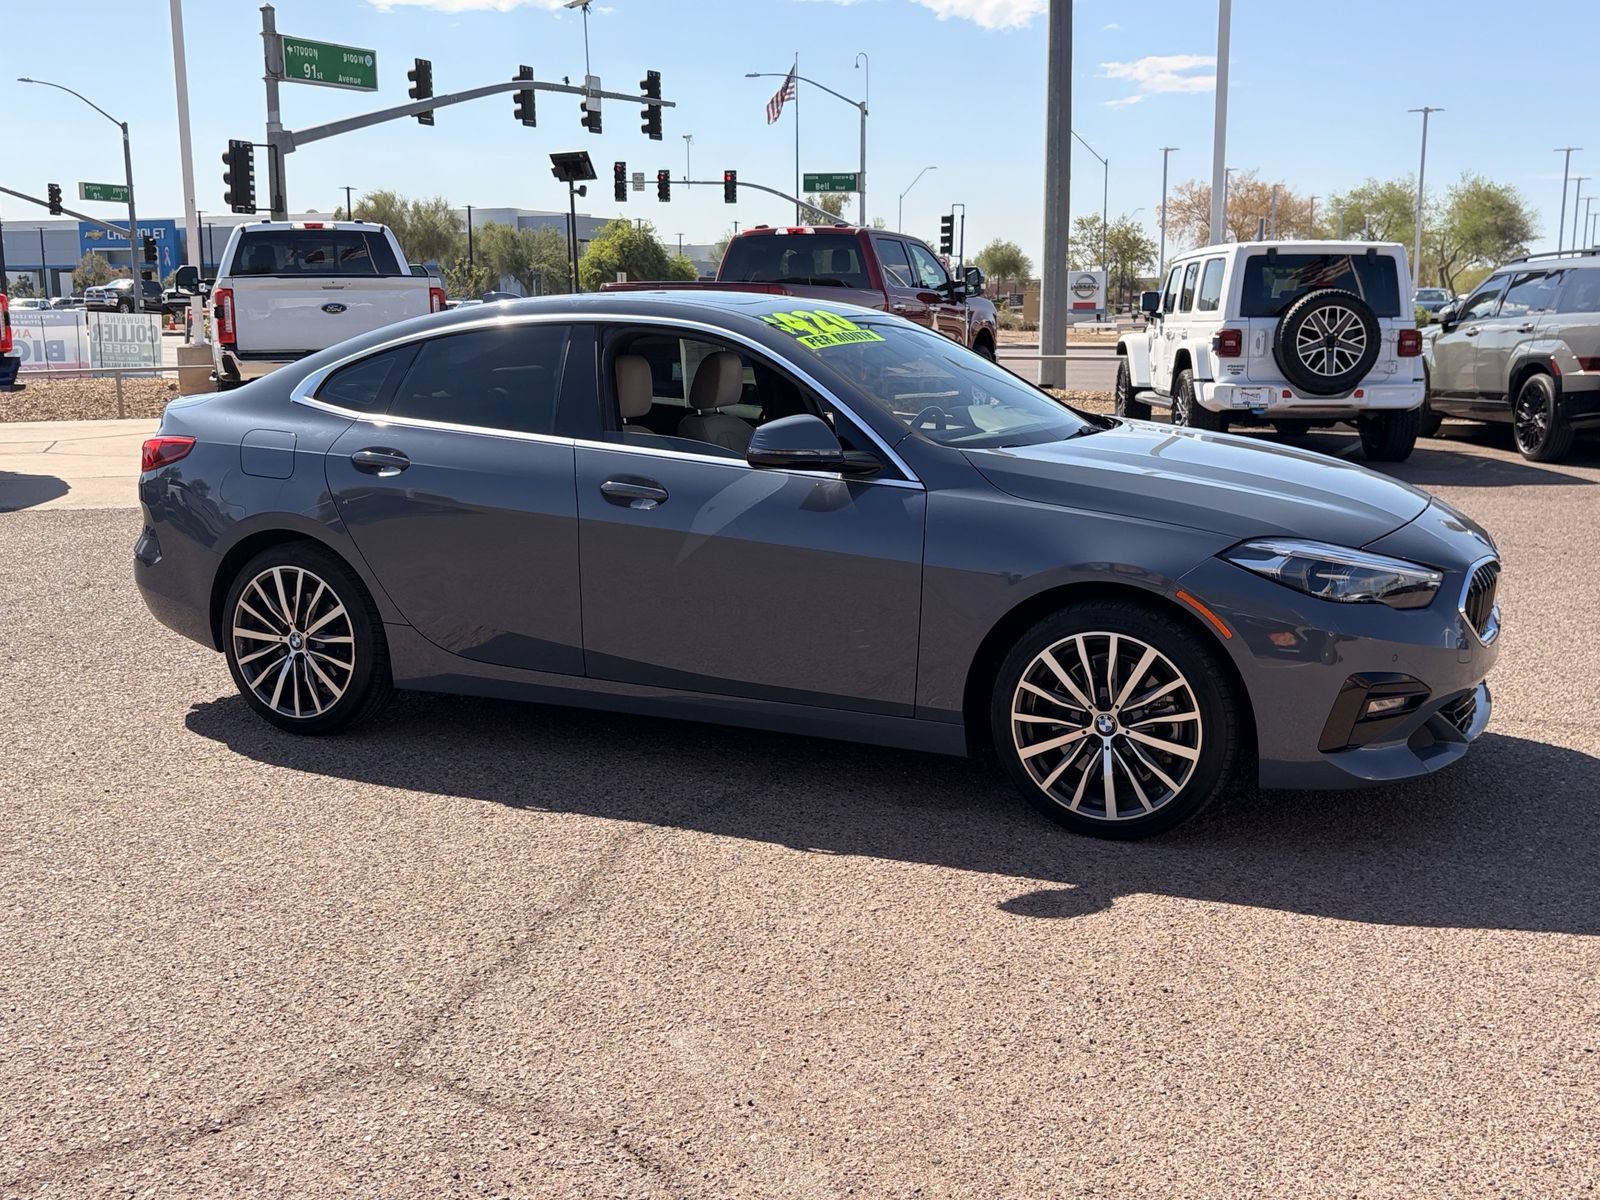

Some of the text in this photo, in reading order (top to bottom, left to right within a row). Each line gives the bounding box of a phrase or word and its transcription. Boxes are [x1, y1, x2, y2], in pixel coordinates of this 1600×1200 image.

[303, 63, 361, 85] 91st Avenue
[815, 182, 830, 191] Bell
[804, 330, 877, 347] PER MONTH
